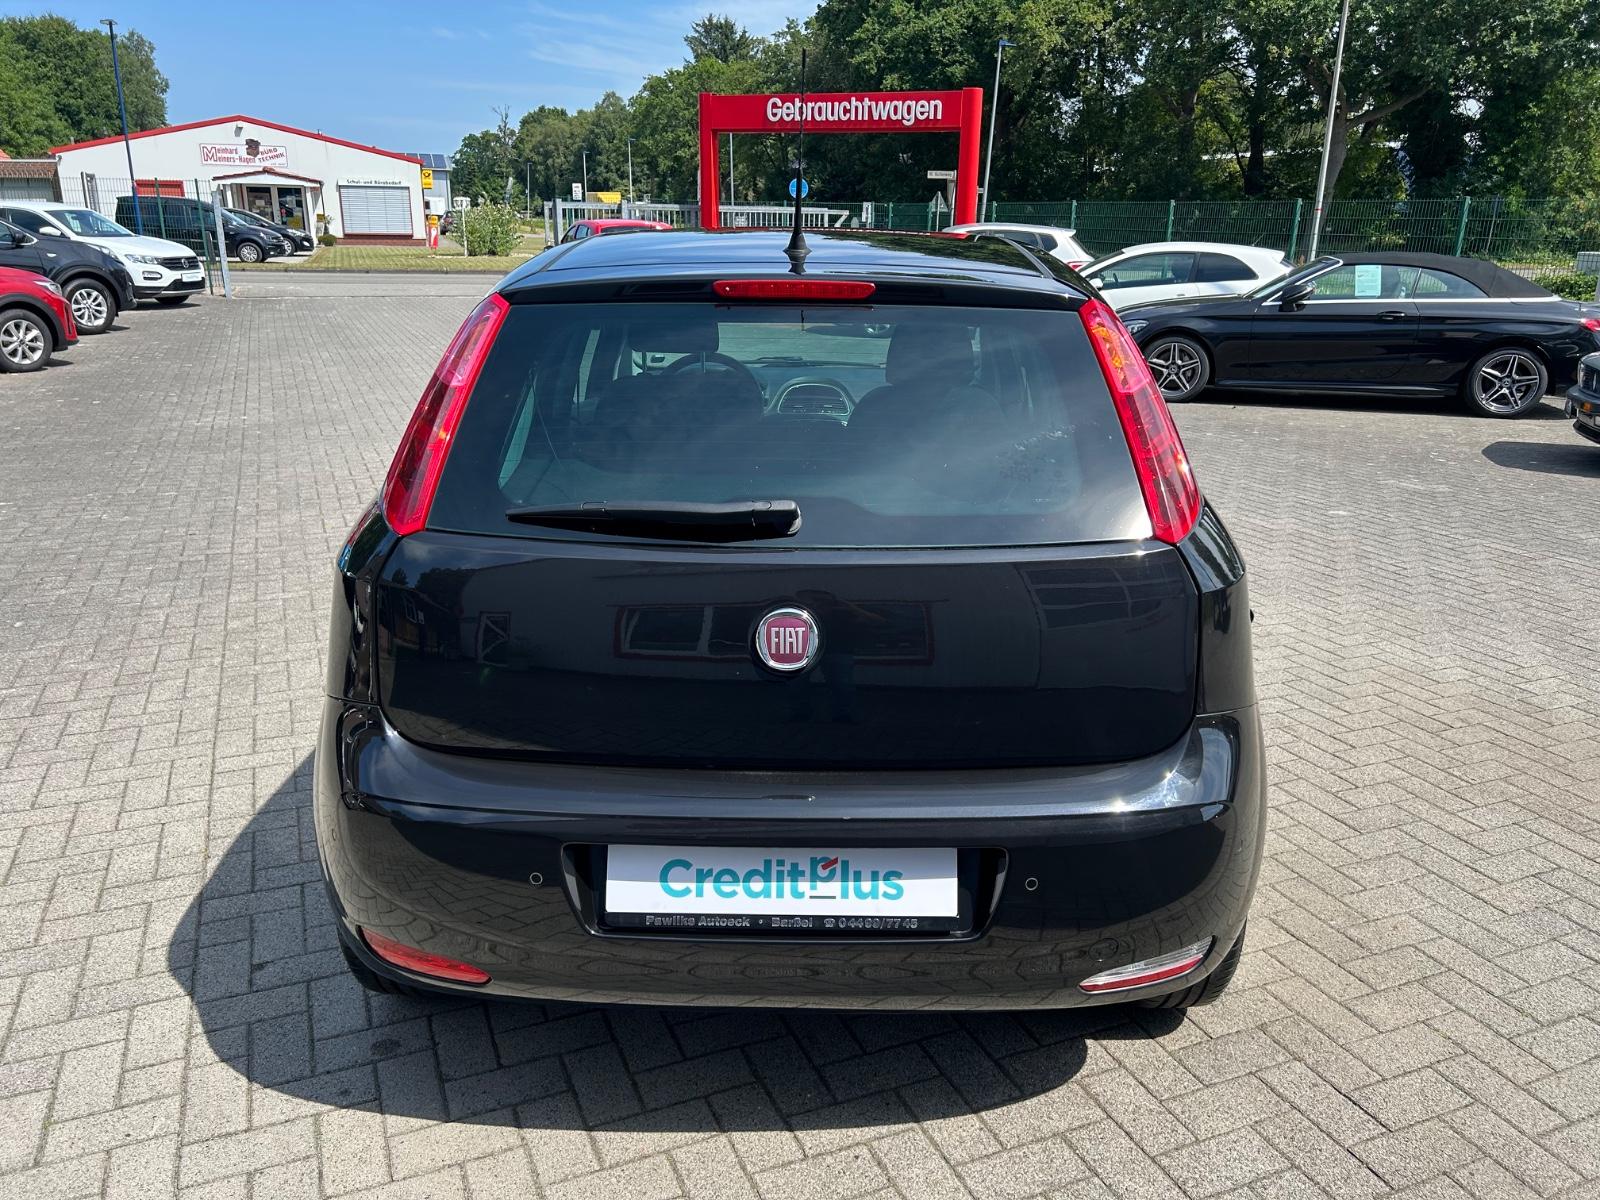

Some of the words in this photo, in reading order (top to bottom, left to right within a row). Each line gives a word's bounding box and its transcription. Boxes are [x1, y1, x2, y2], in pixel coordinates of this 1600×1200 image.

[766, 97, 943, 126] Gebrauchtwagen
[258, 152, 286, 163] TECHNIK
[260, 147, 278, 155] BÜRO
[770, 627, 806, 654] FIAT
